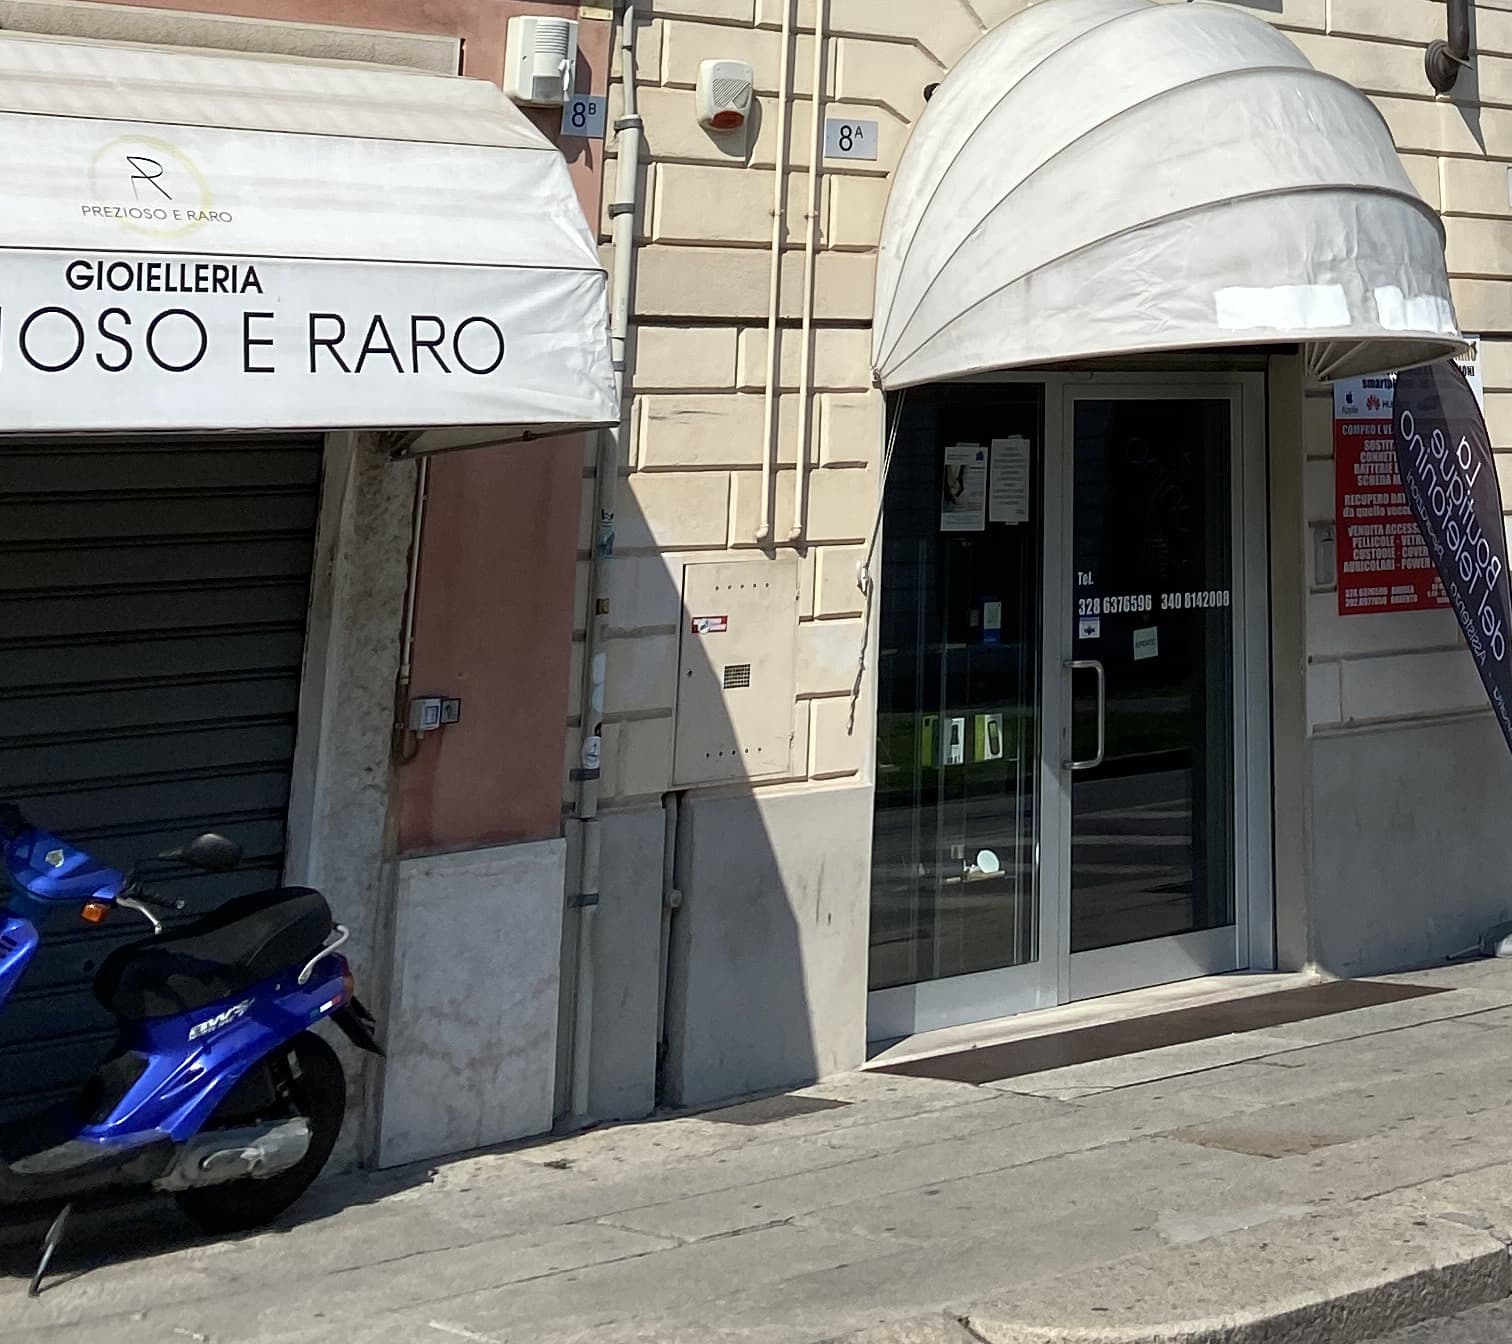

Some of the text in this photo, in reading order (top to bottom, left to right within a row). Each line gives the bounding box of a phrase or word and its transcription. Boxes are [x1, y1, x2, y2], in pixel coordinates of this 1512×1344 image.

[570, 100, 597, 128] 8B
[838, 124, 864, 152] 8A
[80, 204, 233, 223] PREZIOSO E RARO
[65, 259, 264, 294] GIOIELLERIA
[0, 306, 505, 375] OSO E RARO
[1364, 439, 1395, 451] SOSTIT
[1360, 451, 1397, 462] CONNETT
[1344, 493, 1389, 505] RECUPERO
[1385, 523, 1420, 534] ACCESS
[1353, 535, 1395, 548] PELLICOLE
[1353, 547, 1395, 560] CUSTODIE
[1401, 557, 1430, 570] POWER
[1078, 590, 1230, 616] 328 6376596 340 8142008
